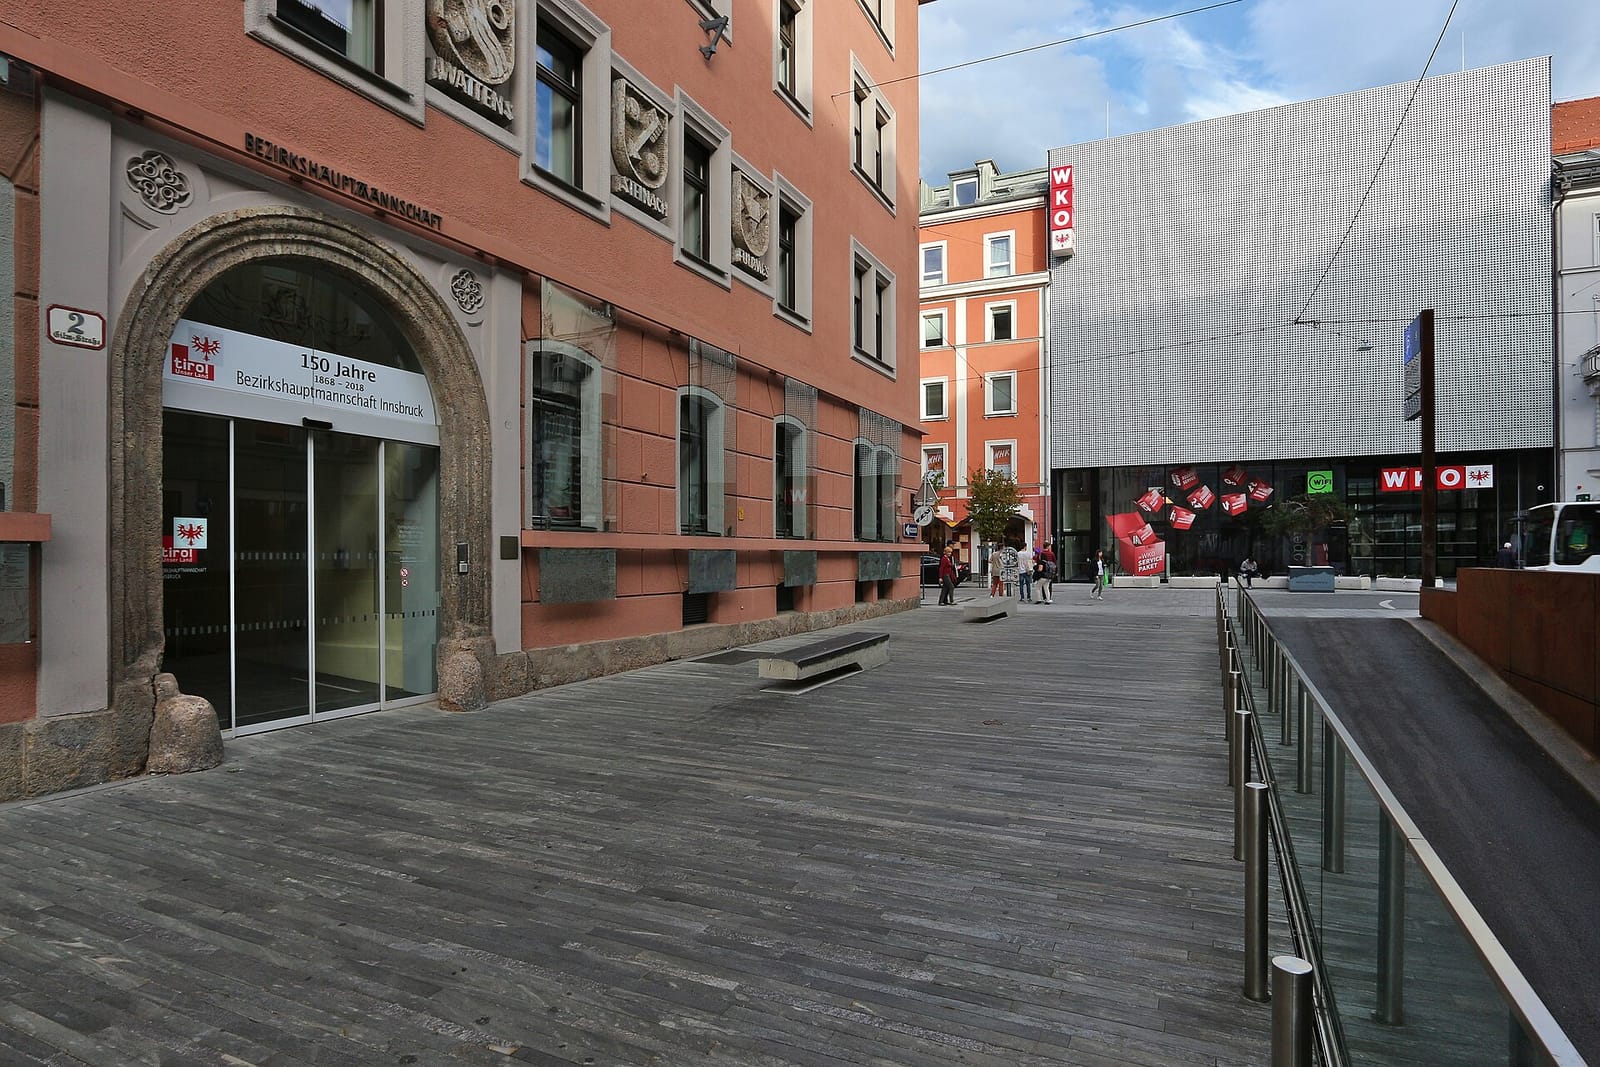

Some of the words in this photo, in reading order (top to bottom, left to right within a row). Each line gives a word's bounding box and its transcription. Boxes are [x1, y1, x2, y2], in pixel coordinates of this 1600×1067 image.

[245, 132, 443, 230] BEZIRKSHAUPTMANNSCHAFT
[1052, 167, 1071, 226] WKO
[68, 313, 84, 335] 2
[174, 357, 209, 374] tirol
[175, 368, 193, 376] Unser
[194, 371, 209, 379] Land
[301, 353, 330, 373] 150
[334, 361, 376, 383] Jahre
[314, 375, 335, 386] 1868
[345, 381, 364, 392] 2018
[236, 370, 377, 410] Bezirkshauptmannschaft
[380, 397, 424, 418] Innsbruck
[1138, 556, 1162, 567] SERVICE
[1138, 563, 1158, 573] PAKET
